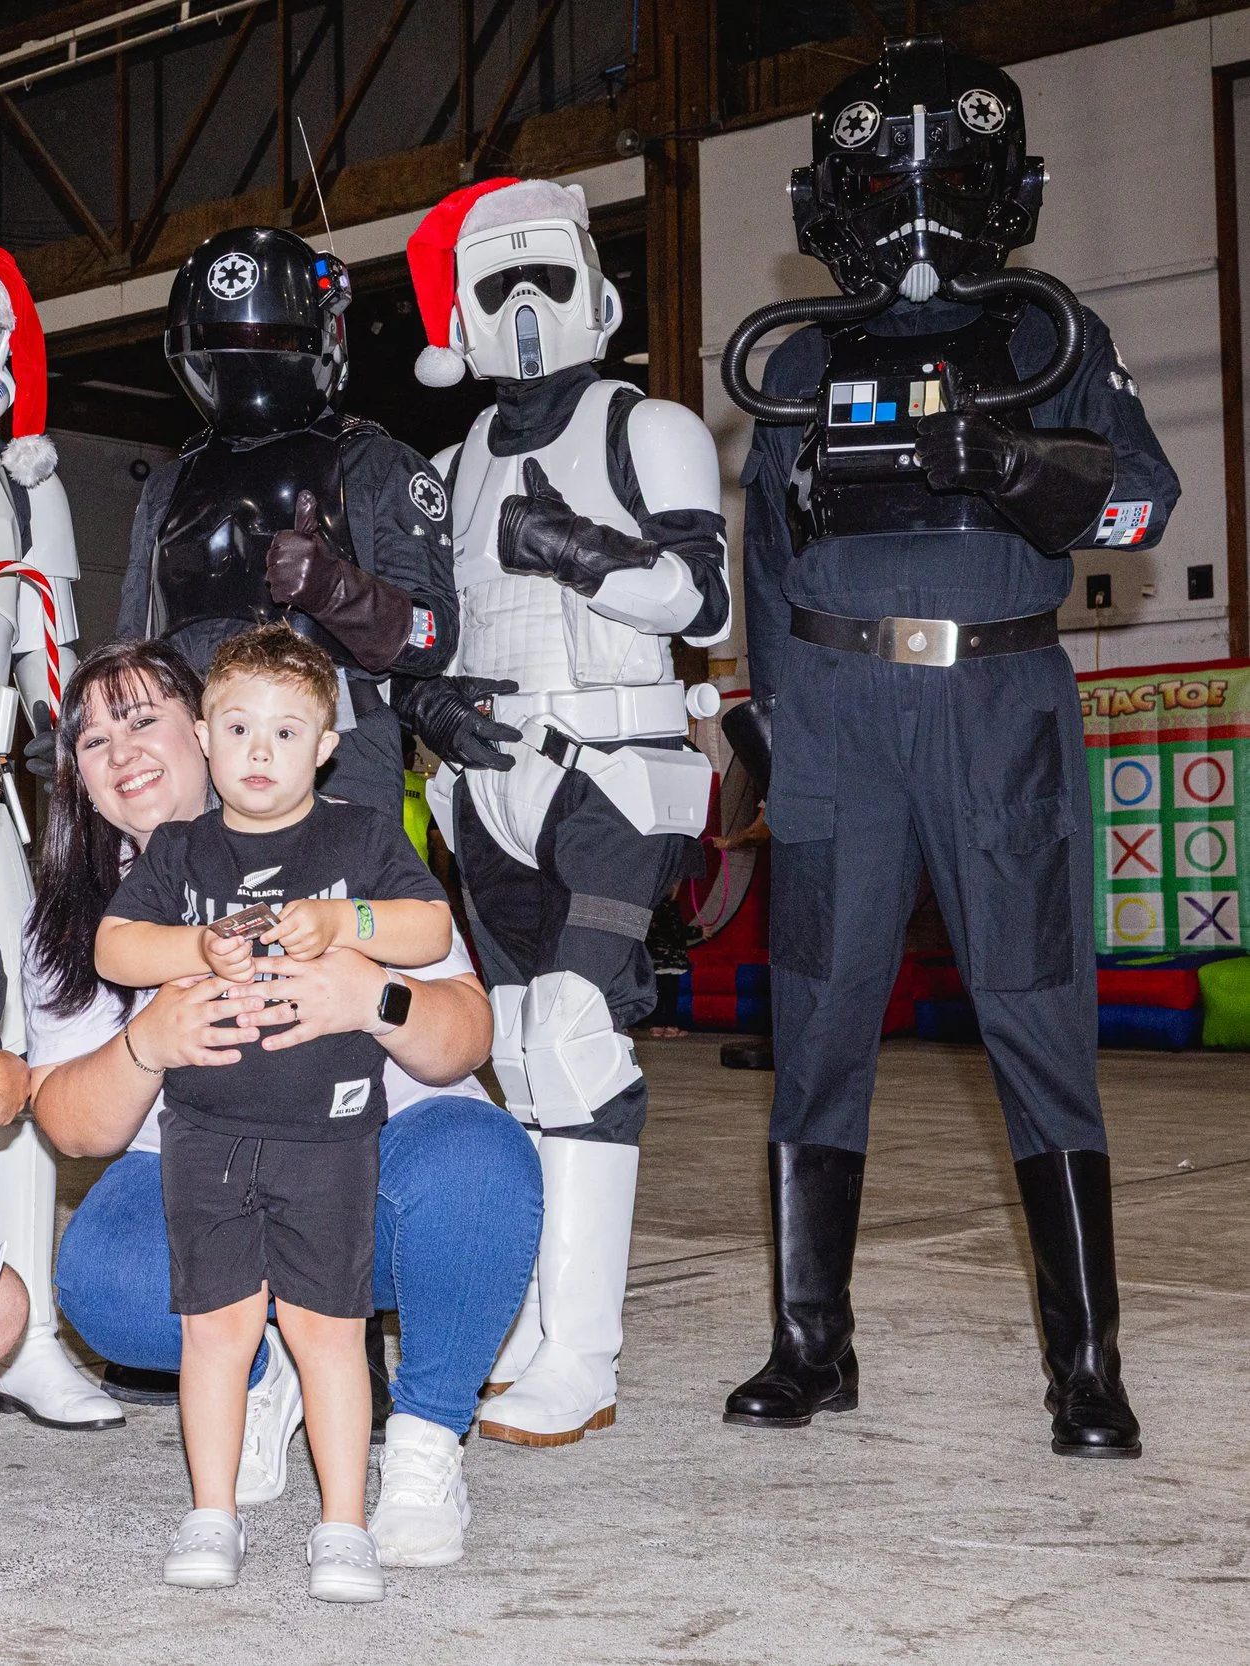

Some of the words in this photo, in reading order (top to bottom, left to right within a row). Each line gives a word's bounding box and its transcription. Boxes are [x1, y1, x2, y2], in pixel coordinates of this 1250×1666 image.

[1092, 687, 1156, 717] TAC
[1158, 680, 1228, 710] TOE
[252, 889, 283, 897] BLACKS
